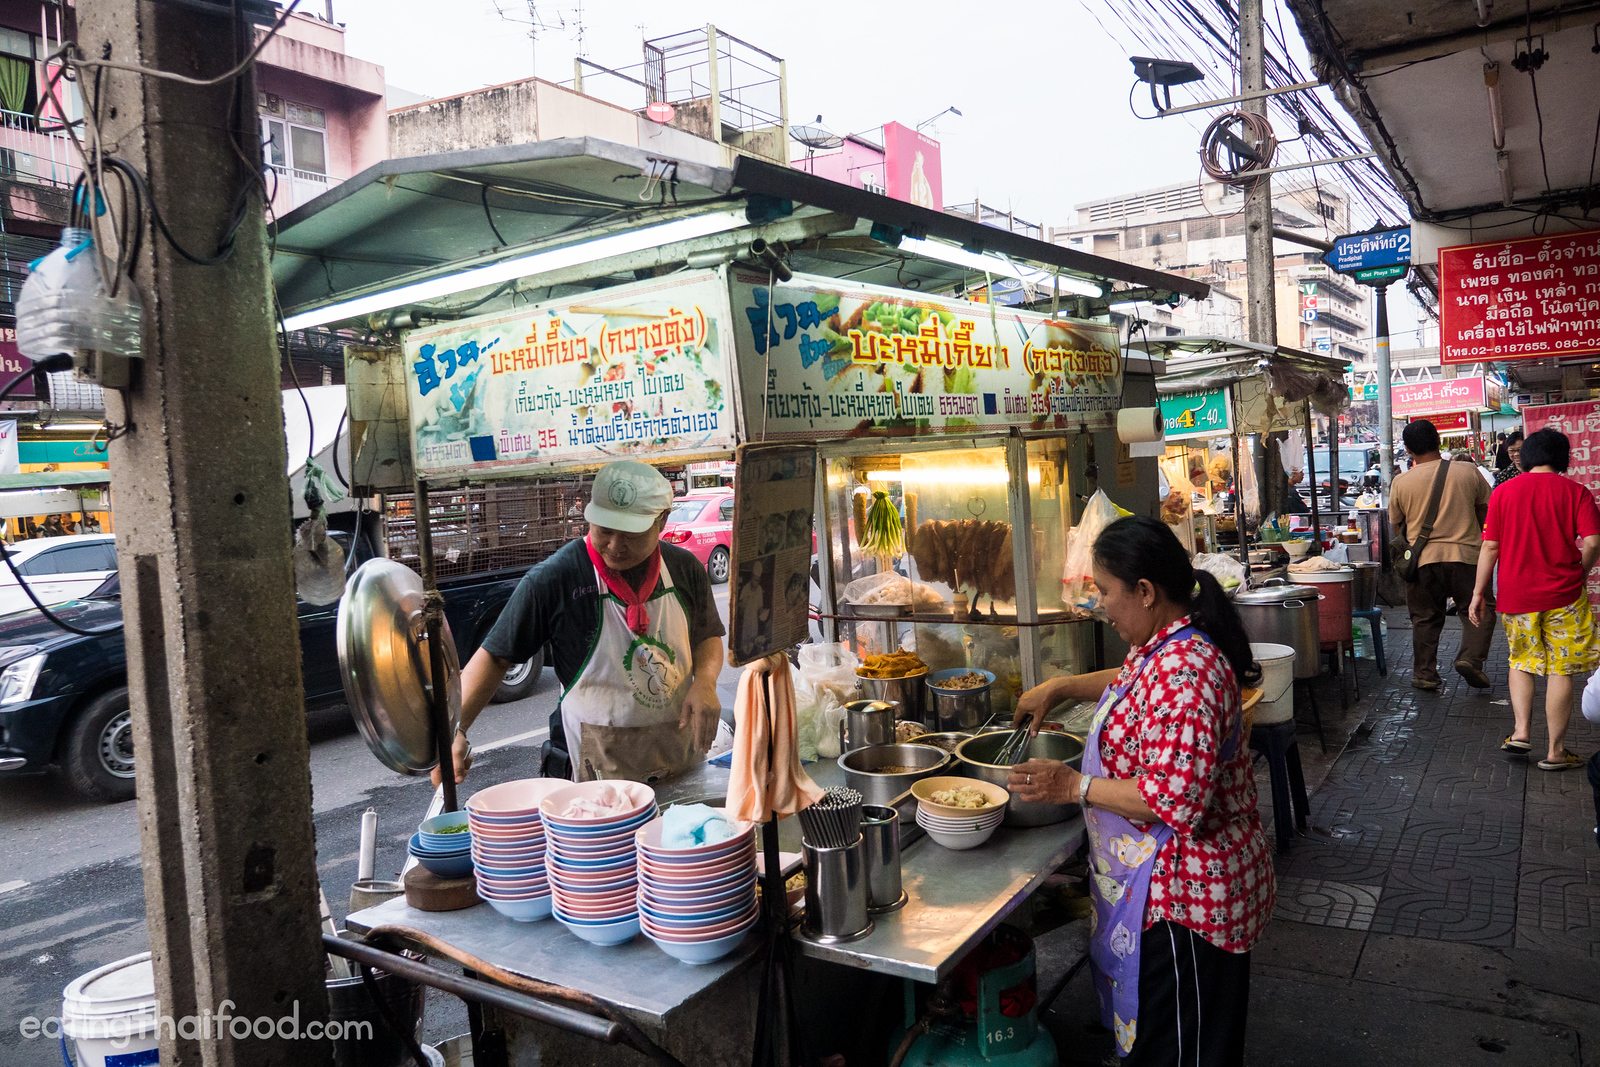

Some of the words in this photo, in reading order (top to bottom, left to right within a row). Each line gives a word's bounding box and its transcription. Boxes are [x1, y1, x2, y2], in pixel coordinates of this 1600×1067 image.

[1338, 233, 1398, 256] ประดิพัทธ์
[1397, 234, 1410, 253] 2
[1460, 275, 1499, 289] เพชร
[1507, 264, 1564, 284] ทองคำ
[1456, 294, 1489, 307] นาค
[1497, 287, 1528, 303] เงิน
[1535, 282, 1577, 300] เหล้า
[1486, 303, 1533, 321] มือถือ
[986, 1026, 1015, 1044] 16.3
